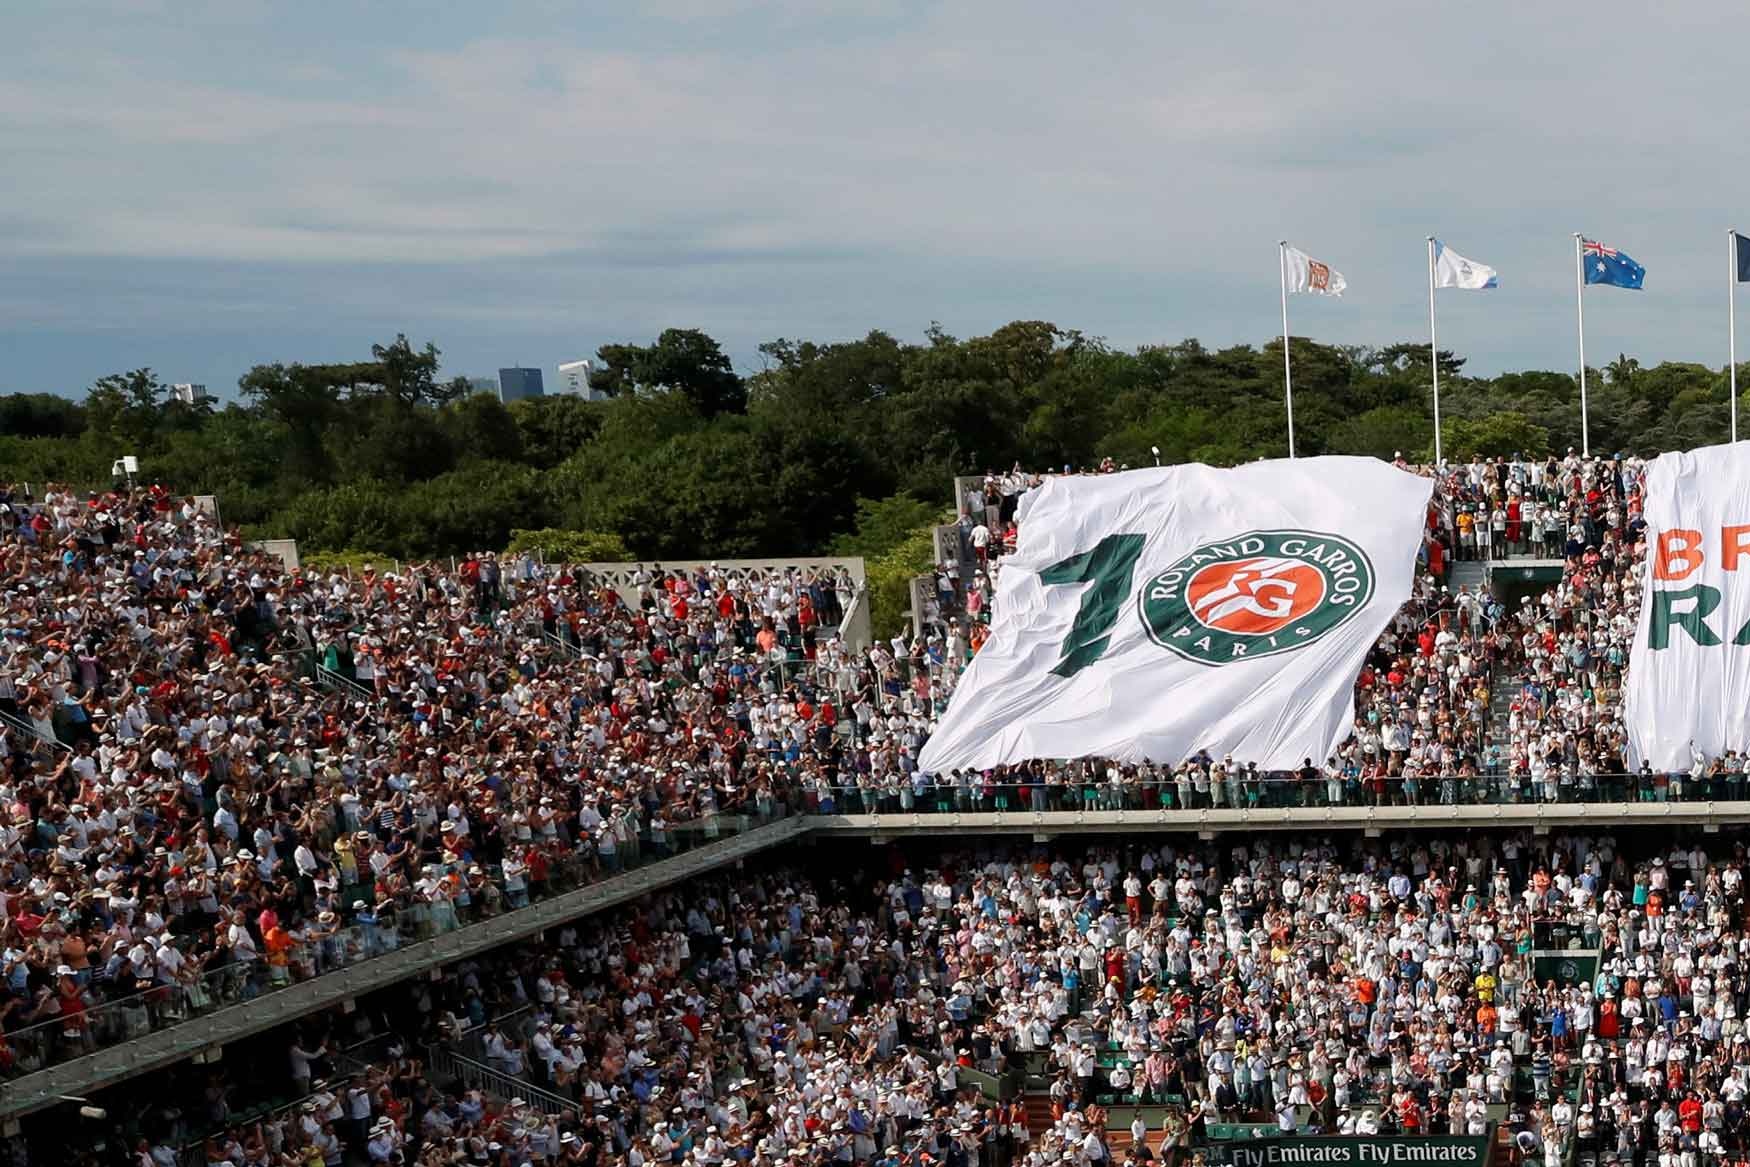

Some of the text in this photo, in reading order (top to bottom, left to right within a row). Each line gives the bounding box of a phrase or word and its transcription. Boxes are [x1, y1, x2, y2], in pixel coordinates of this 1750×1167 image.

[1151, 536, 1356, 606] ROLAND GARROS
[1174, 626, 1312, 656] PARIS
[1233, 1144, 1351, 1167] Fly Emirates
[1359, 1142, 1477, 1165] Fly Emirates
